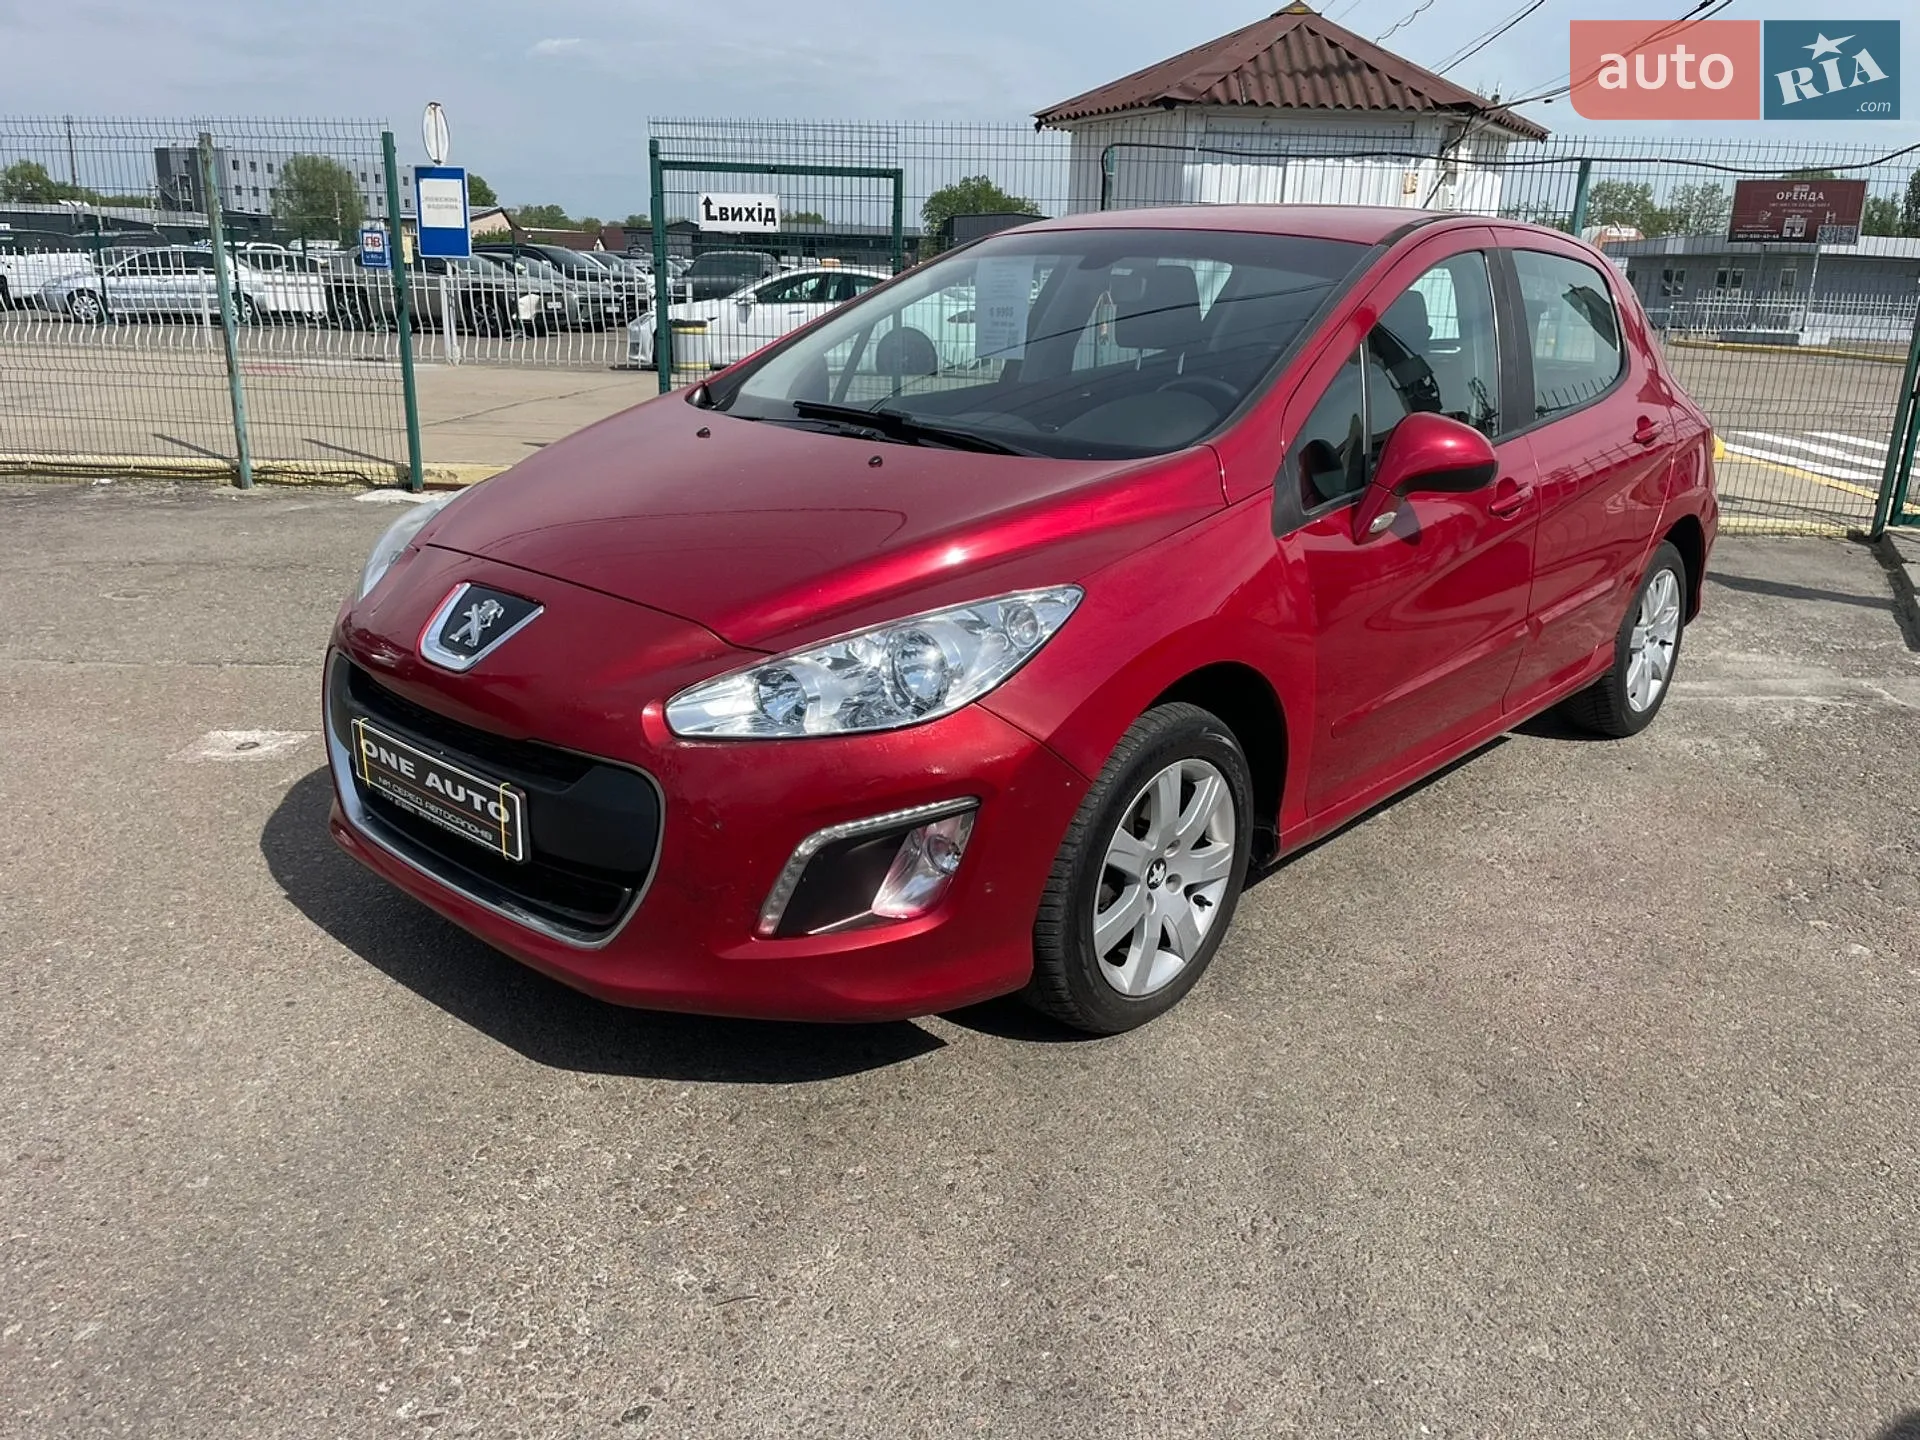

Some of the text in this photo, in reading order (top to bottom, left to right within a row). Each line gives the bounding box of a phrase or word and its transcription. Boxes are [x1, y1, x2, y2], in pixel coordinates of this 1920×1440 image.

[1776, 191, 1824, 202] ОРЕНДА
[718, 202, 777, 227] вихід
[365, 236, 381, 248] ПВ
[361, 738, 510, 824] ONE AUTO
